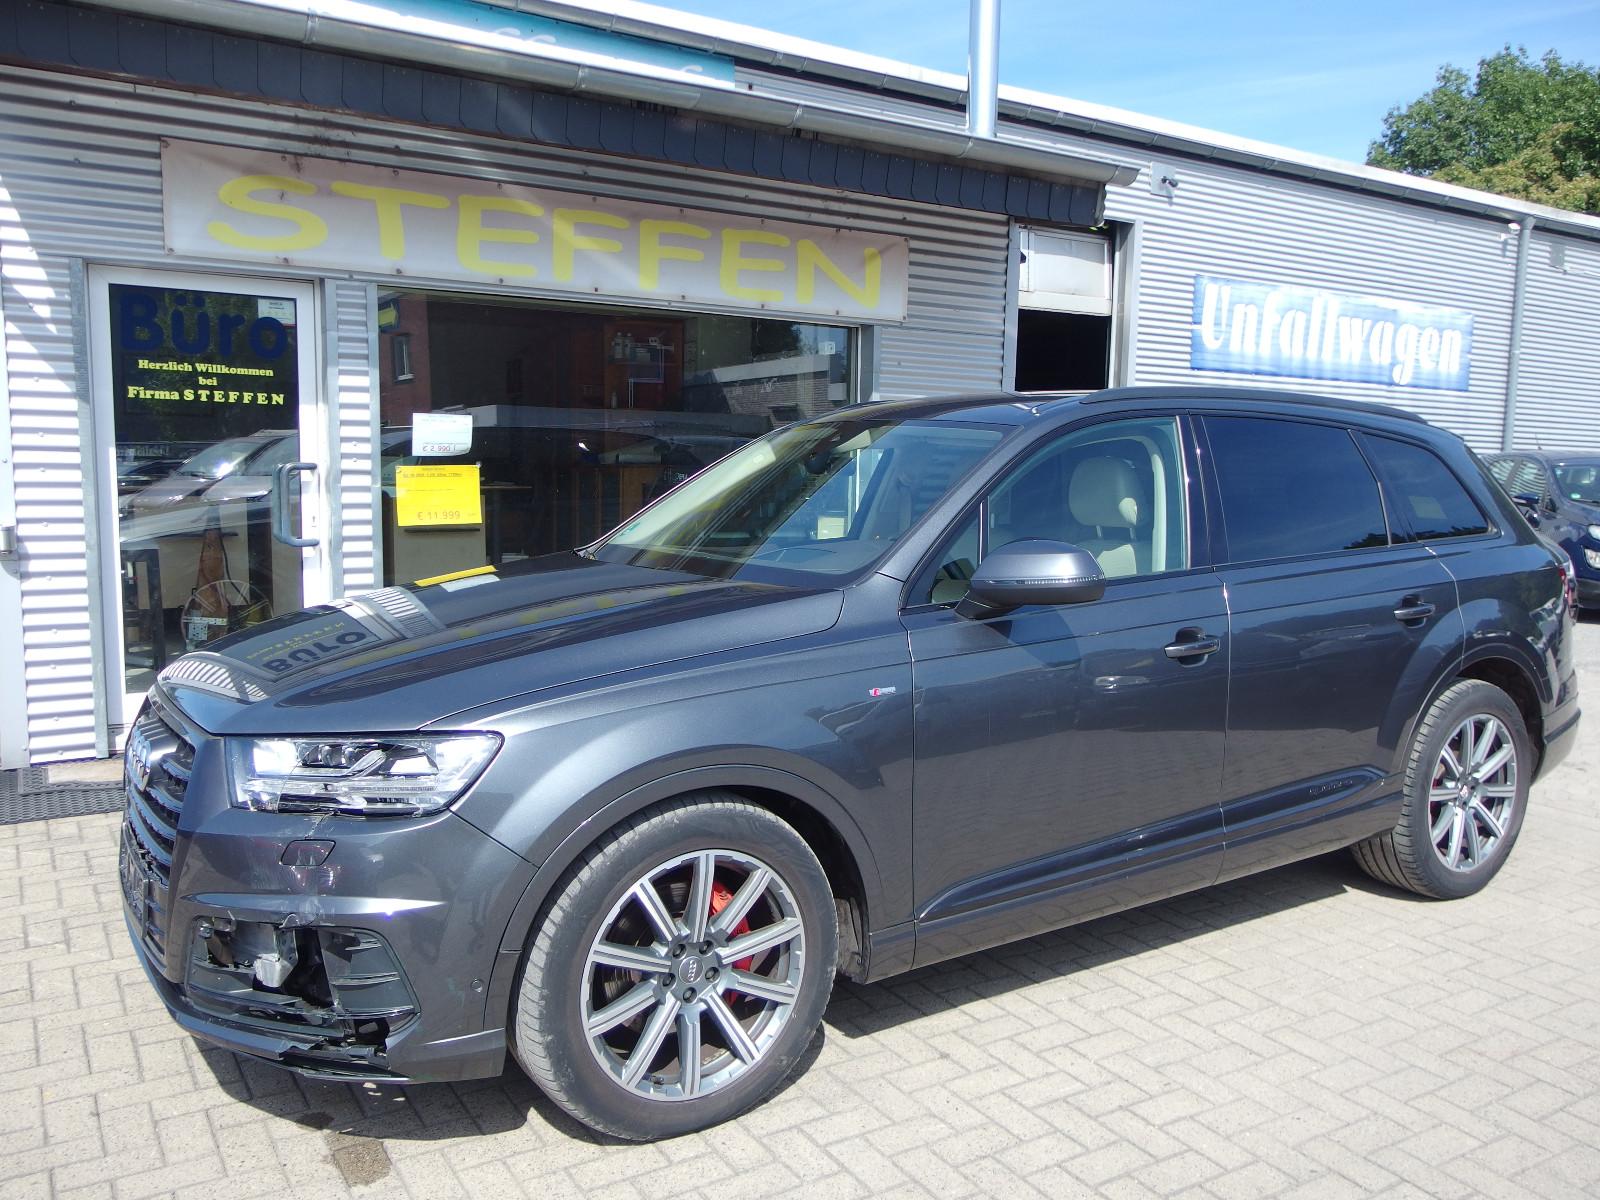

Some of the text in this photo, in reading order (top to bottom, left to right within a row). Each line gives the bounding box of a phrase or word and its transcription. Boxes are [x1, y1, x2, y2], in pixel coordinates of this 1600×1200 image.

[207, 174, 882, 308] STEFFEN
[120, 293, 289, 359] Büro
[1202, 282, 1462, 386] Unfallwagen
[137, 359, 274, 377] Herzlich Willkommen
[198, 376, 218, 386] bei
[127, 385, 180, 401] Firma
